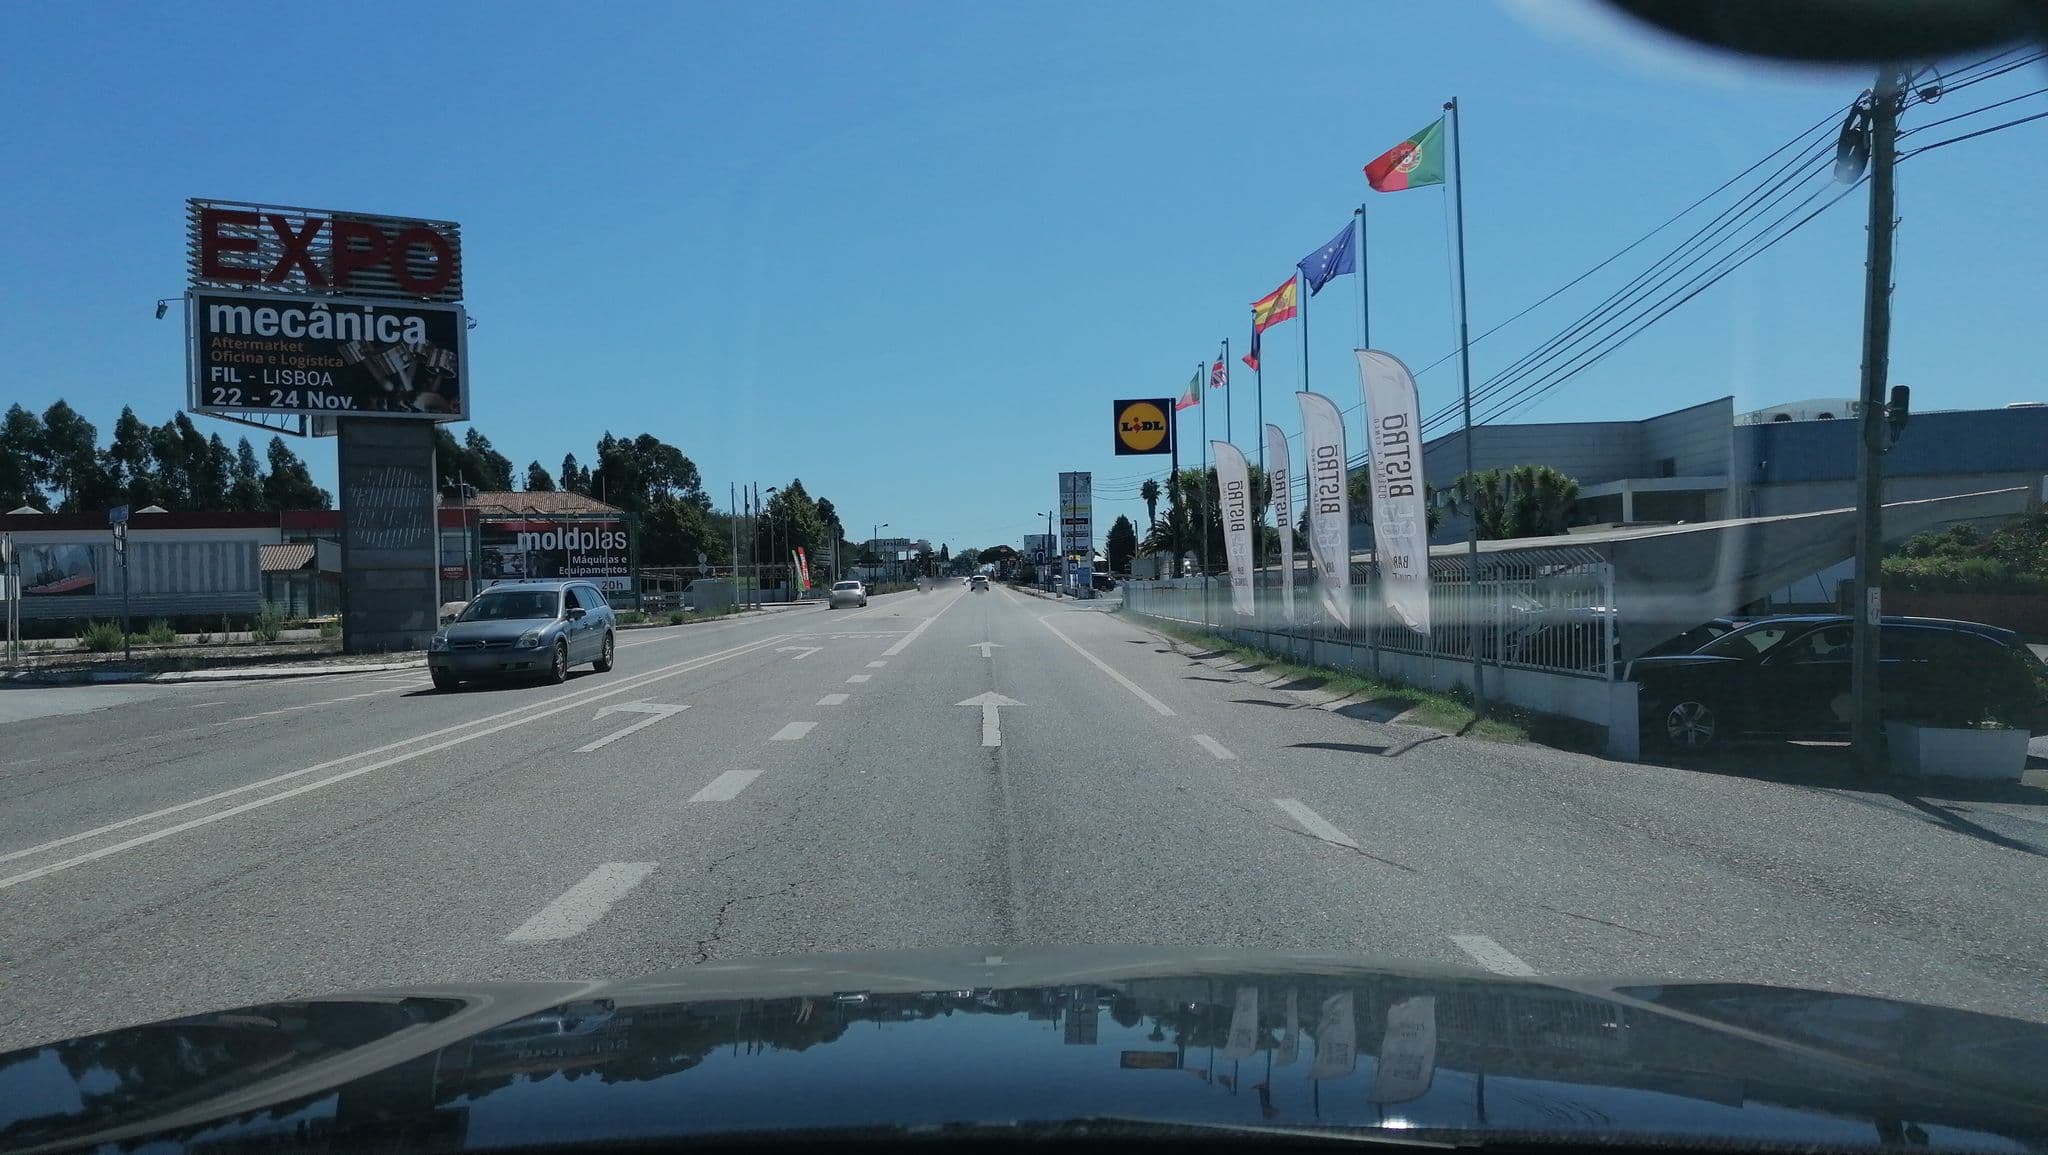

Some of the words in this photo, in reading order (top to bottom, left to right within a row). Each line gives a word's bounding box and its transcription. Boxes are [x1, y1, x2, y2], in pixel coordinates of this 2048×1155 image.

[201, 209, 453, 294] EXPO
[209, 302, 426, 345] mecânica
[211, 336, 304, 353] Aftermarket
[211, 350, 264, 364] Oficina
[268, 355, 277, 365] e
[211, 366, 242, 383] FIL
[263, 369, 333, 386] LISBOA
[211, 387, 243, 406] 22
[270, 389, 300, 408] 24
[307, 391, 358, 410] Nov.
[517, 527, 627, 554] moldplas
[601, 580, 623, 591] 20h
